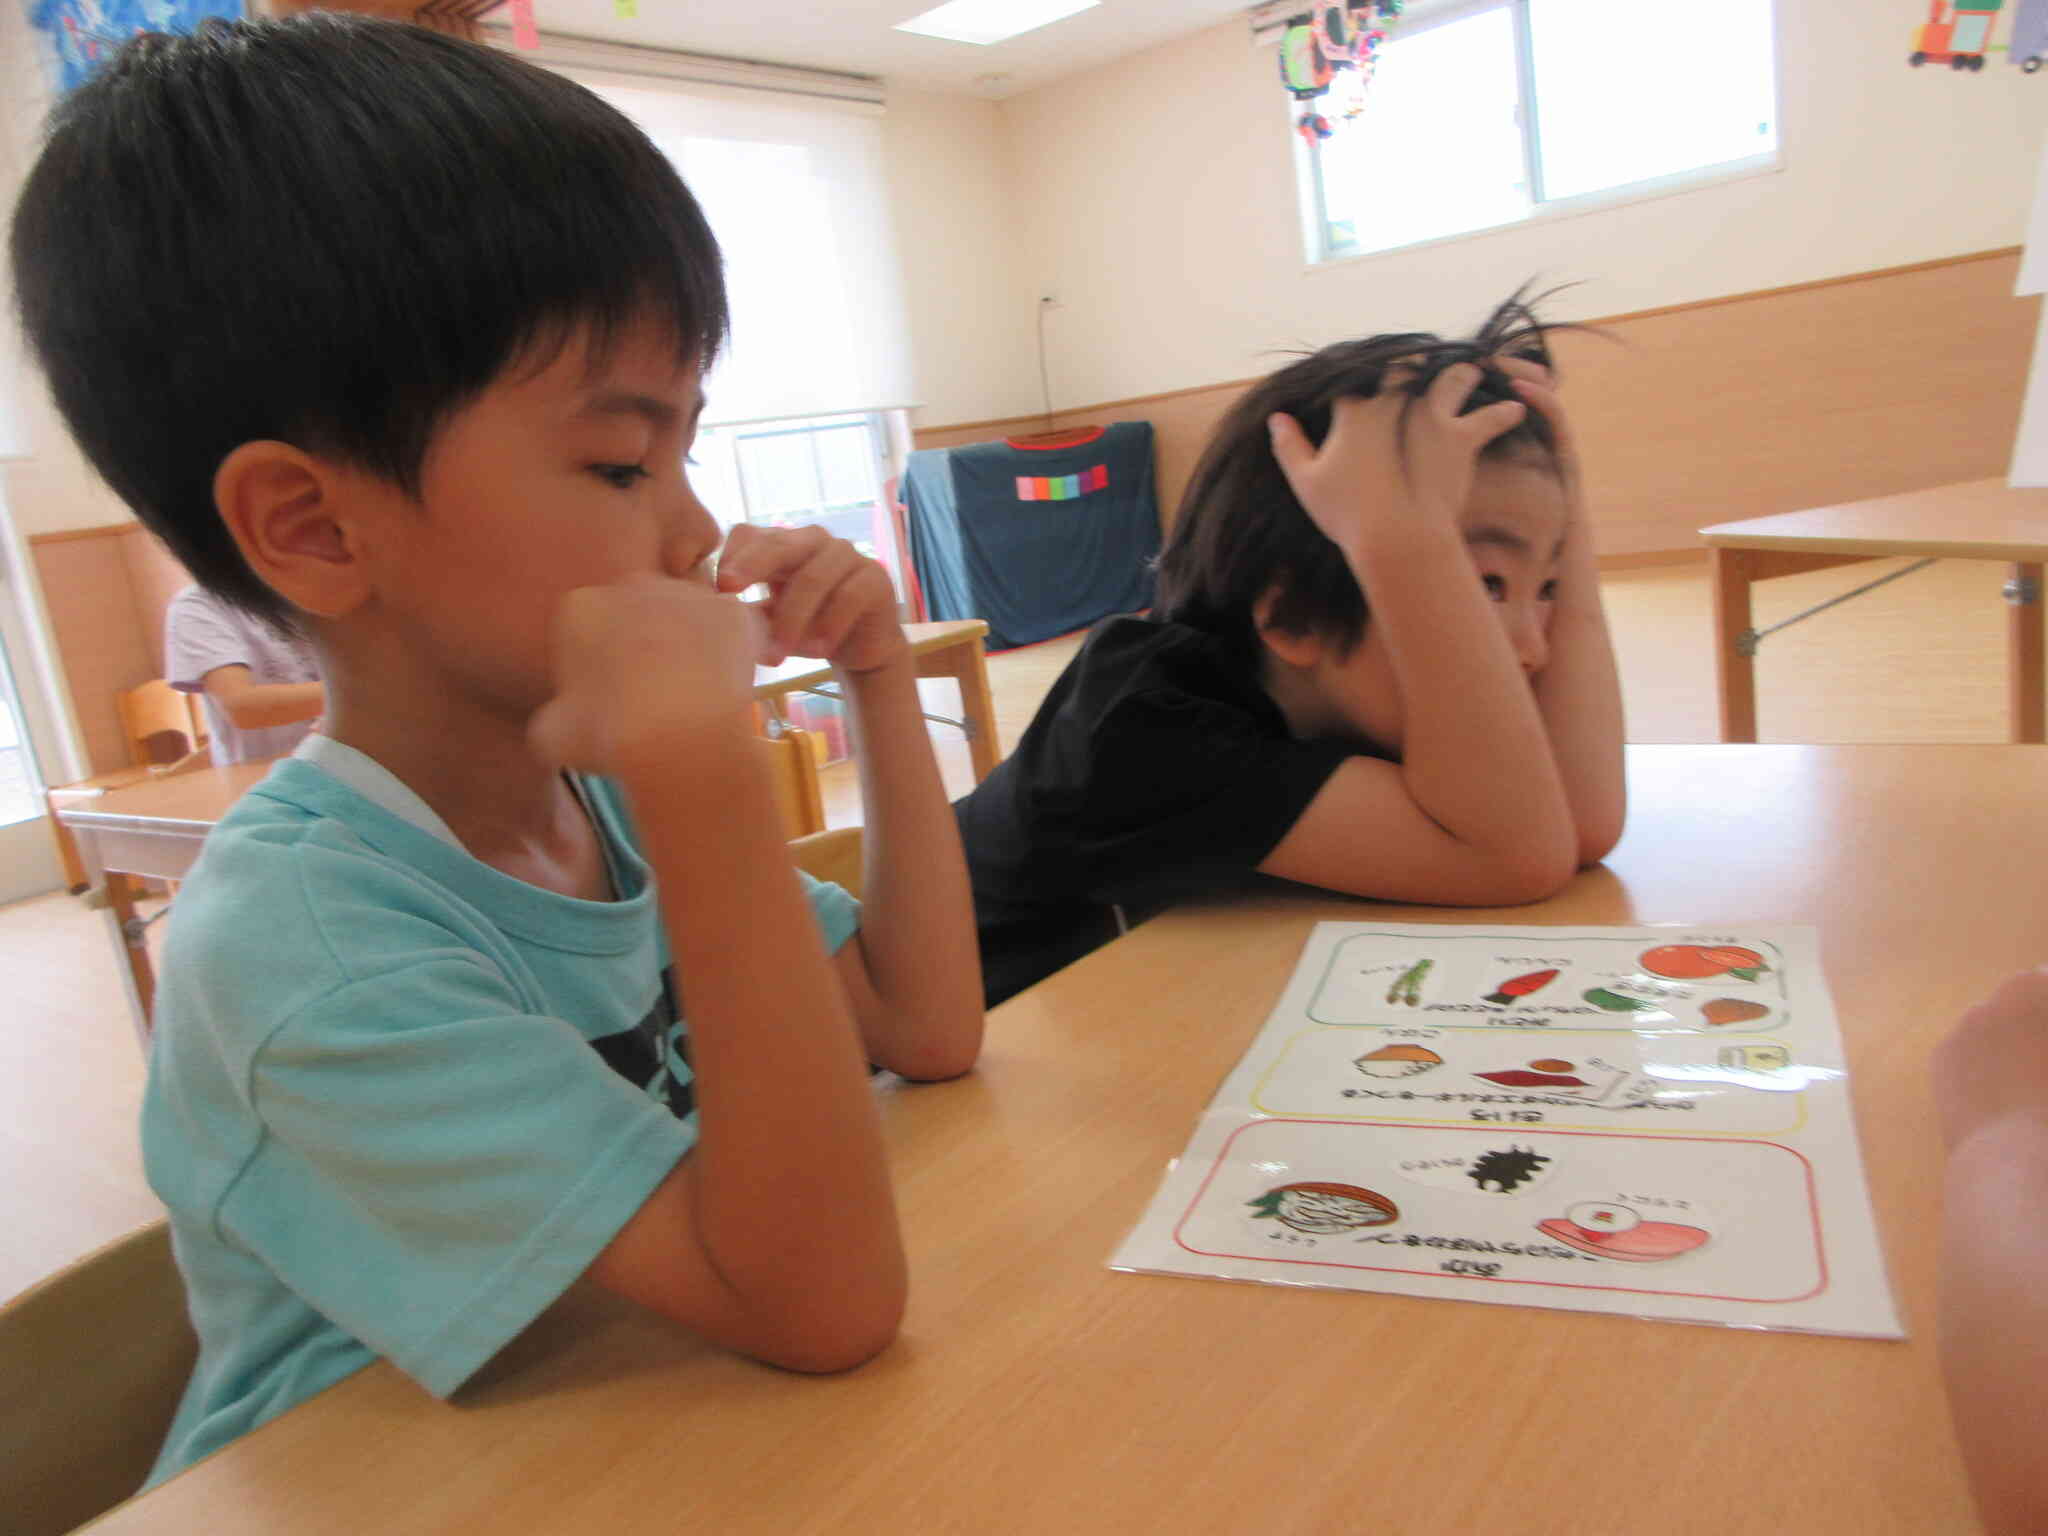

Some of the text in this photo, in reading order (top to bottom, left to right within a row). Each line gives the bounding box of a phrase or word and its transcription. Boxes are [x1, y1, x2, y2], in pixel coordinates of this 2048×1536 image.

[1380, 1028, 1440, 1039] ごはん
[1470, 1108, 1542, 1123] きいろ
[1440, 1259, 1502, 1278] あか
